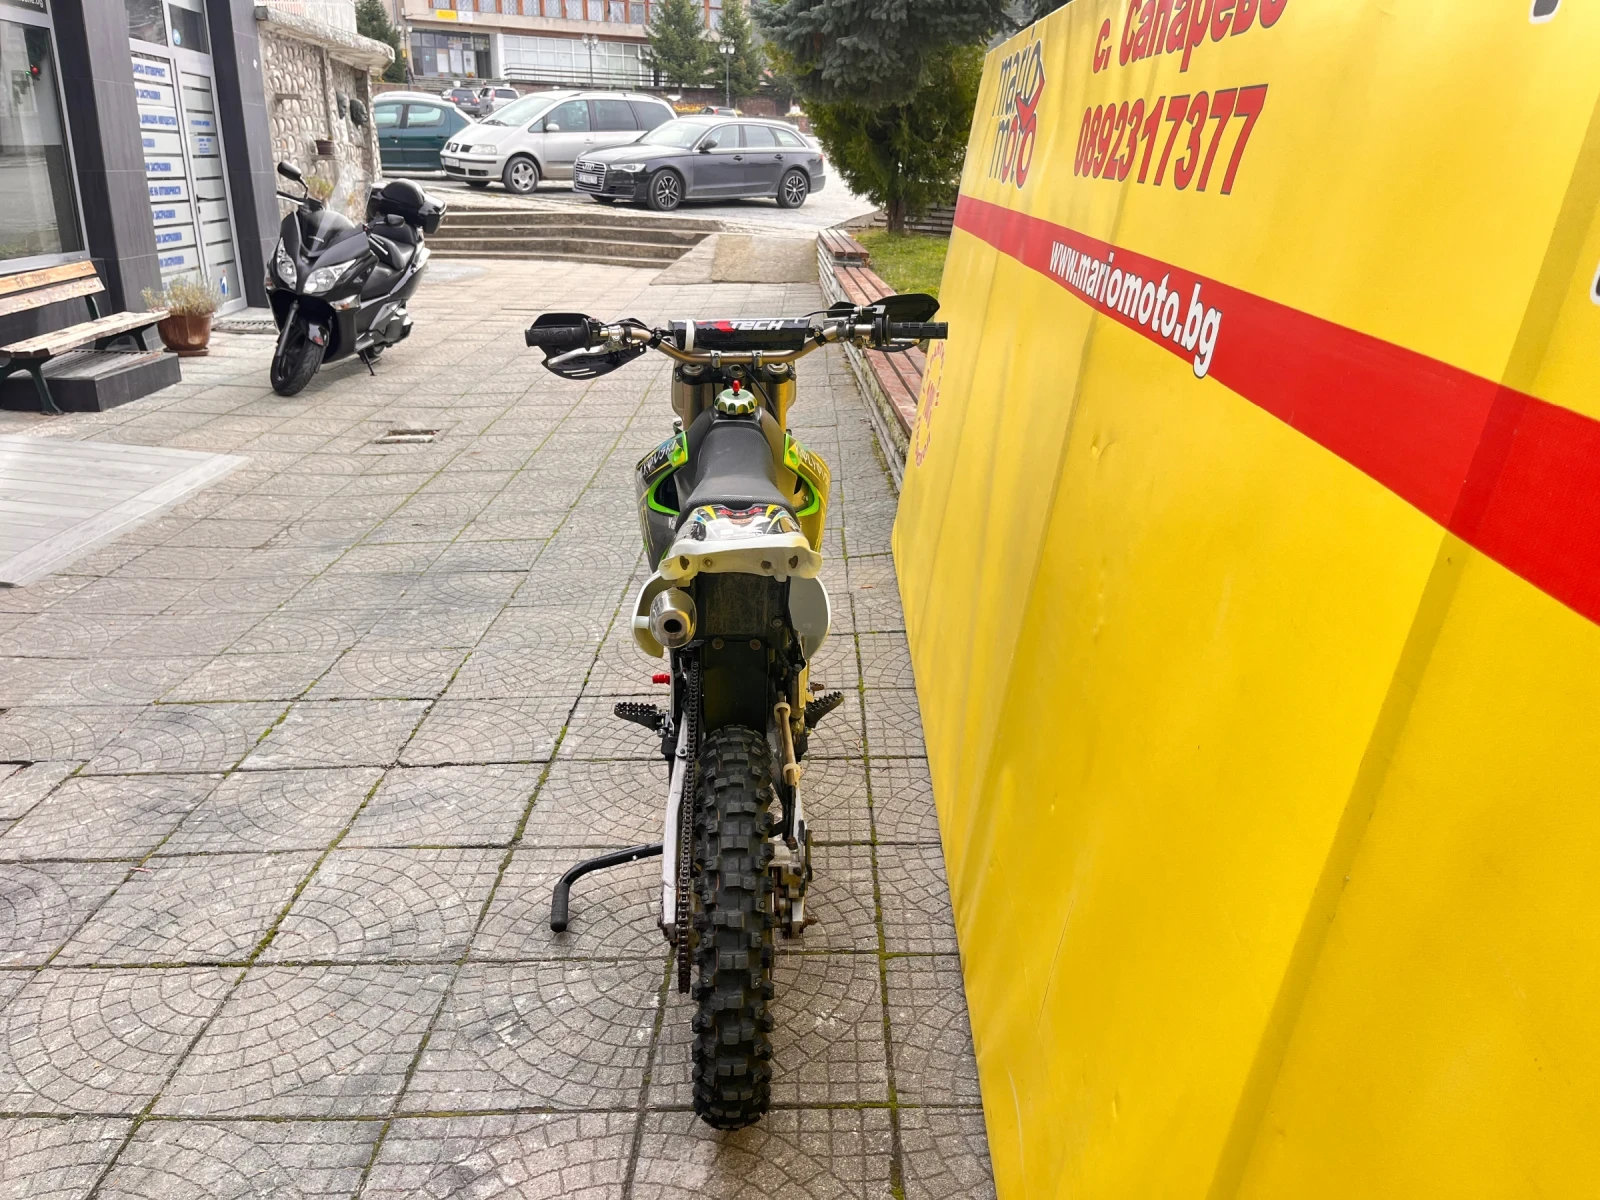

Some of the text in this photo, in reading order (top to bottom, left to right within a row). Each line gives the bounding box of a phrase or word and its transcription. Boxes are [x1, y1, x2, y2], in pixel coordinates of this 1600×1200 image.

[989, 113, 1037, 188] moto
[1073, 84, 1268, 195] 0892317377
[1049, 240, 1222, 379] www.mariomoto.bg
